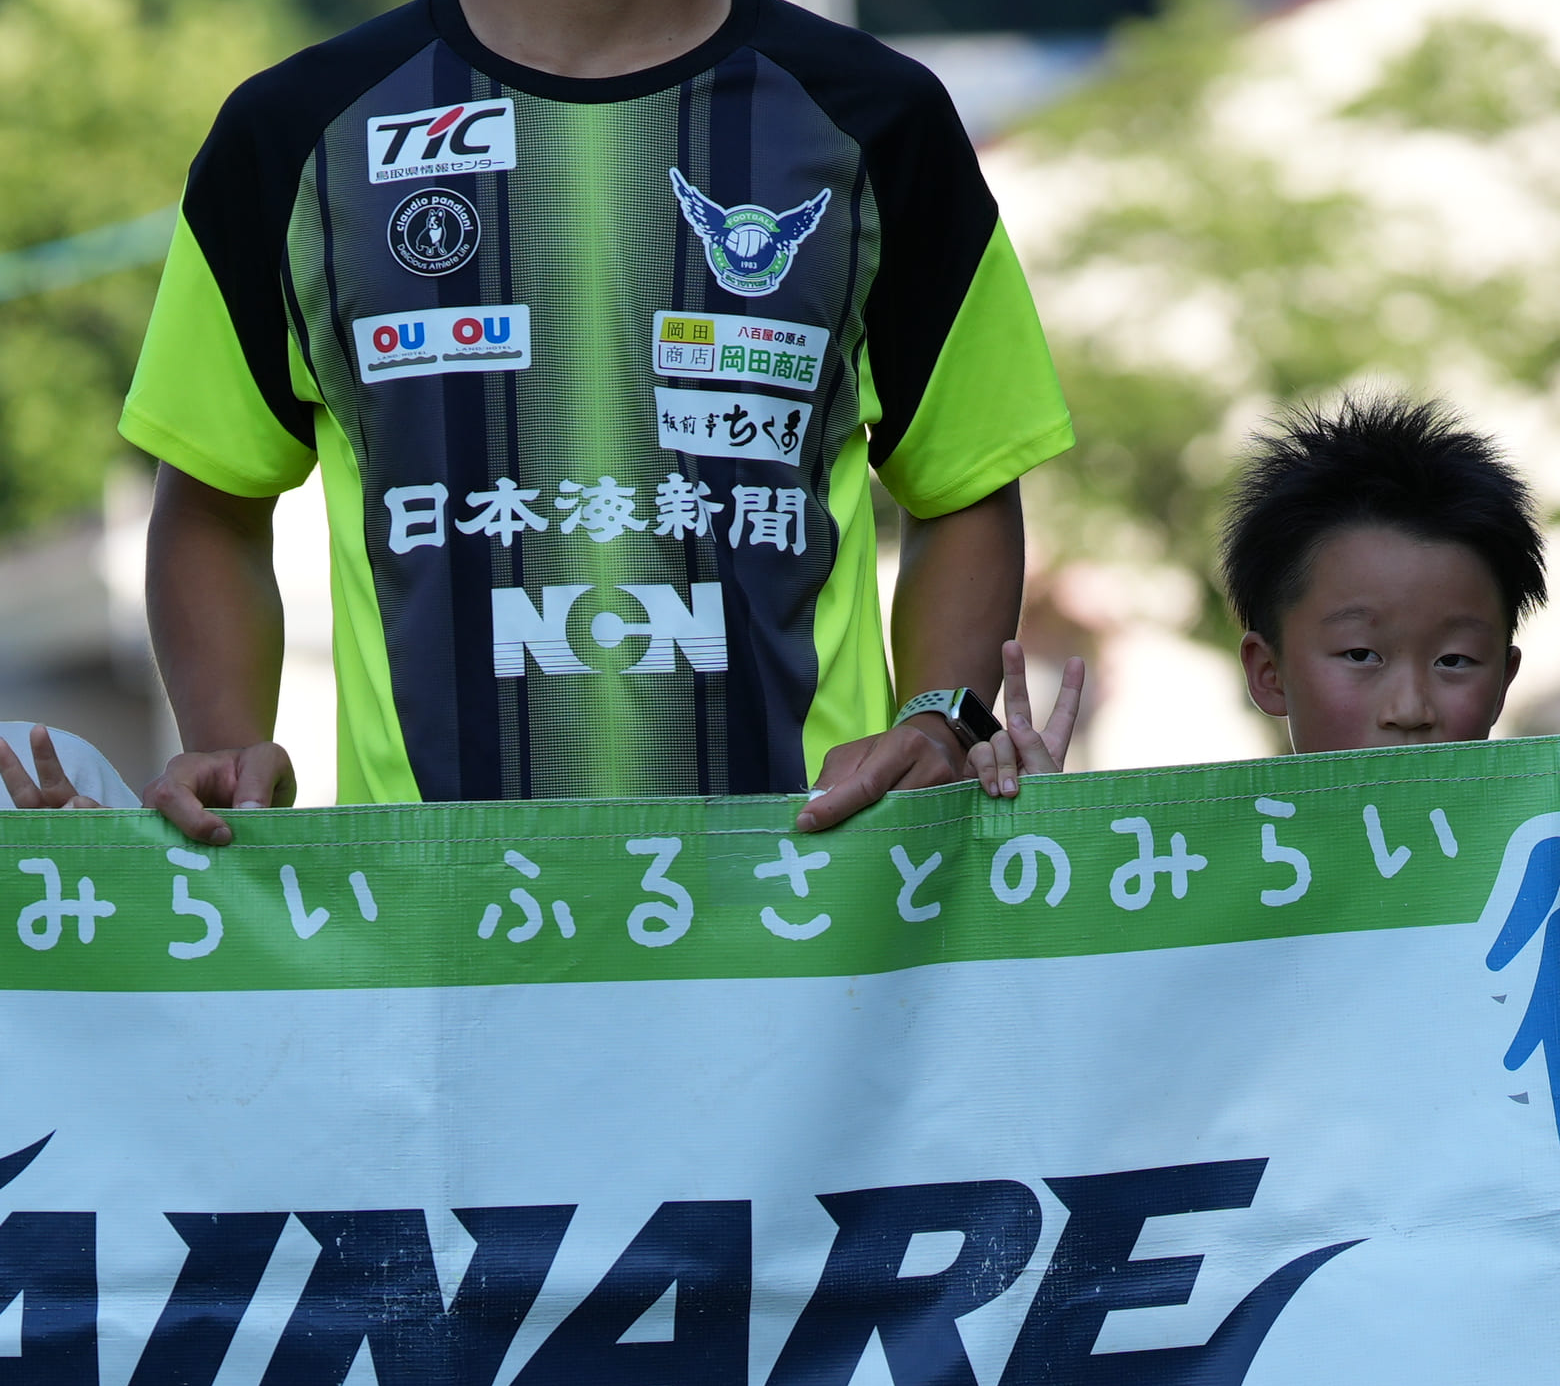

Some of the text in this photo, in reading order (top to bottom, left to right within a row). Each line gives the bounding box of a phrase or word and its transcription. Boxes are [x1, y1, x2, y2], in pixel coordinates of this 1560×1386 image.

[376, 159, 505, 182] 鳥取県情報センター
[396, 197, 428, 232] claudio
[727, 213, 776, 231] FOOTBALL
[373, 317, 510, 354] OU OU
[667, 321, 708, 341] 岡田
[738, 326, 807, 347] 八百屋の原点
[666, 345, 709, 365] 商店
[719, 344, 818, 384] 岡田商店
[383, 472, 808, 556] 日本海新聞
[491, 582, 728, 677] NCN
[477, 797, 1459, 948] ふるさとのみらい
